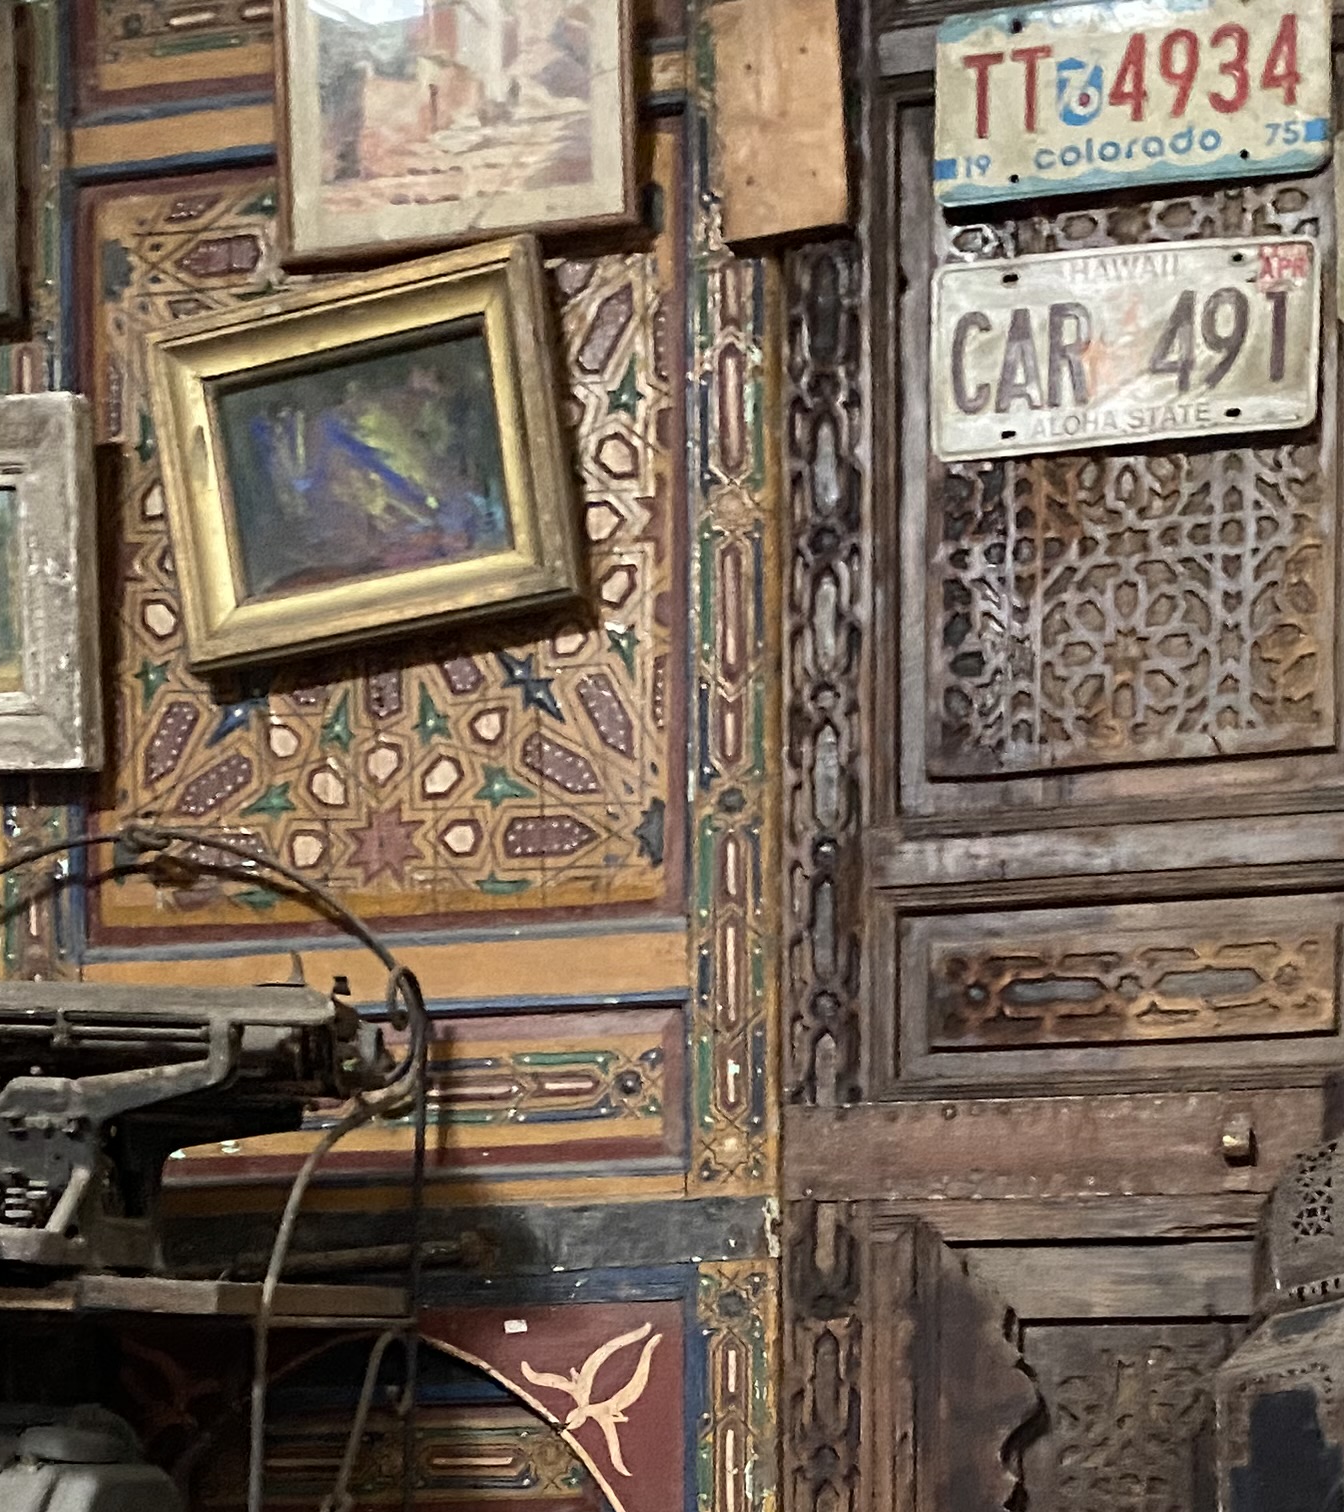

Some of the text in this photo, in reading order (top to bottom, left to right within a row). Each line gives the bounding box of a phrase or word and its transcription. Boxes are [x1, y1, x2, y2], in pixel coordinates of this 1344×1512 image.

[962, 45, 1052, 139] TT
[1108, 13, 1302, 122] 4934
[963, 154, 992, 178] 19
[1264, 123, 1300, 146] 75
[1063, 254, 1182, 283] HAWAII
[950, 287, 1289, 414] CAR 491
[1031, 403, 1211, 438] ALOHA STATE
